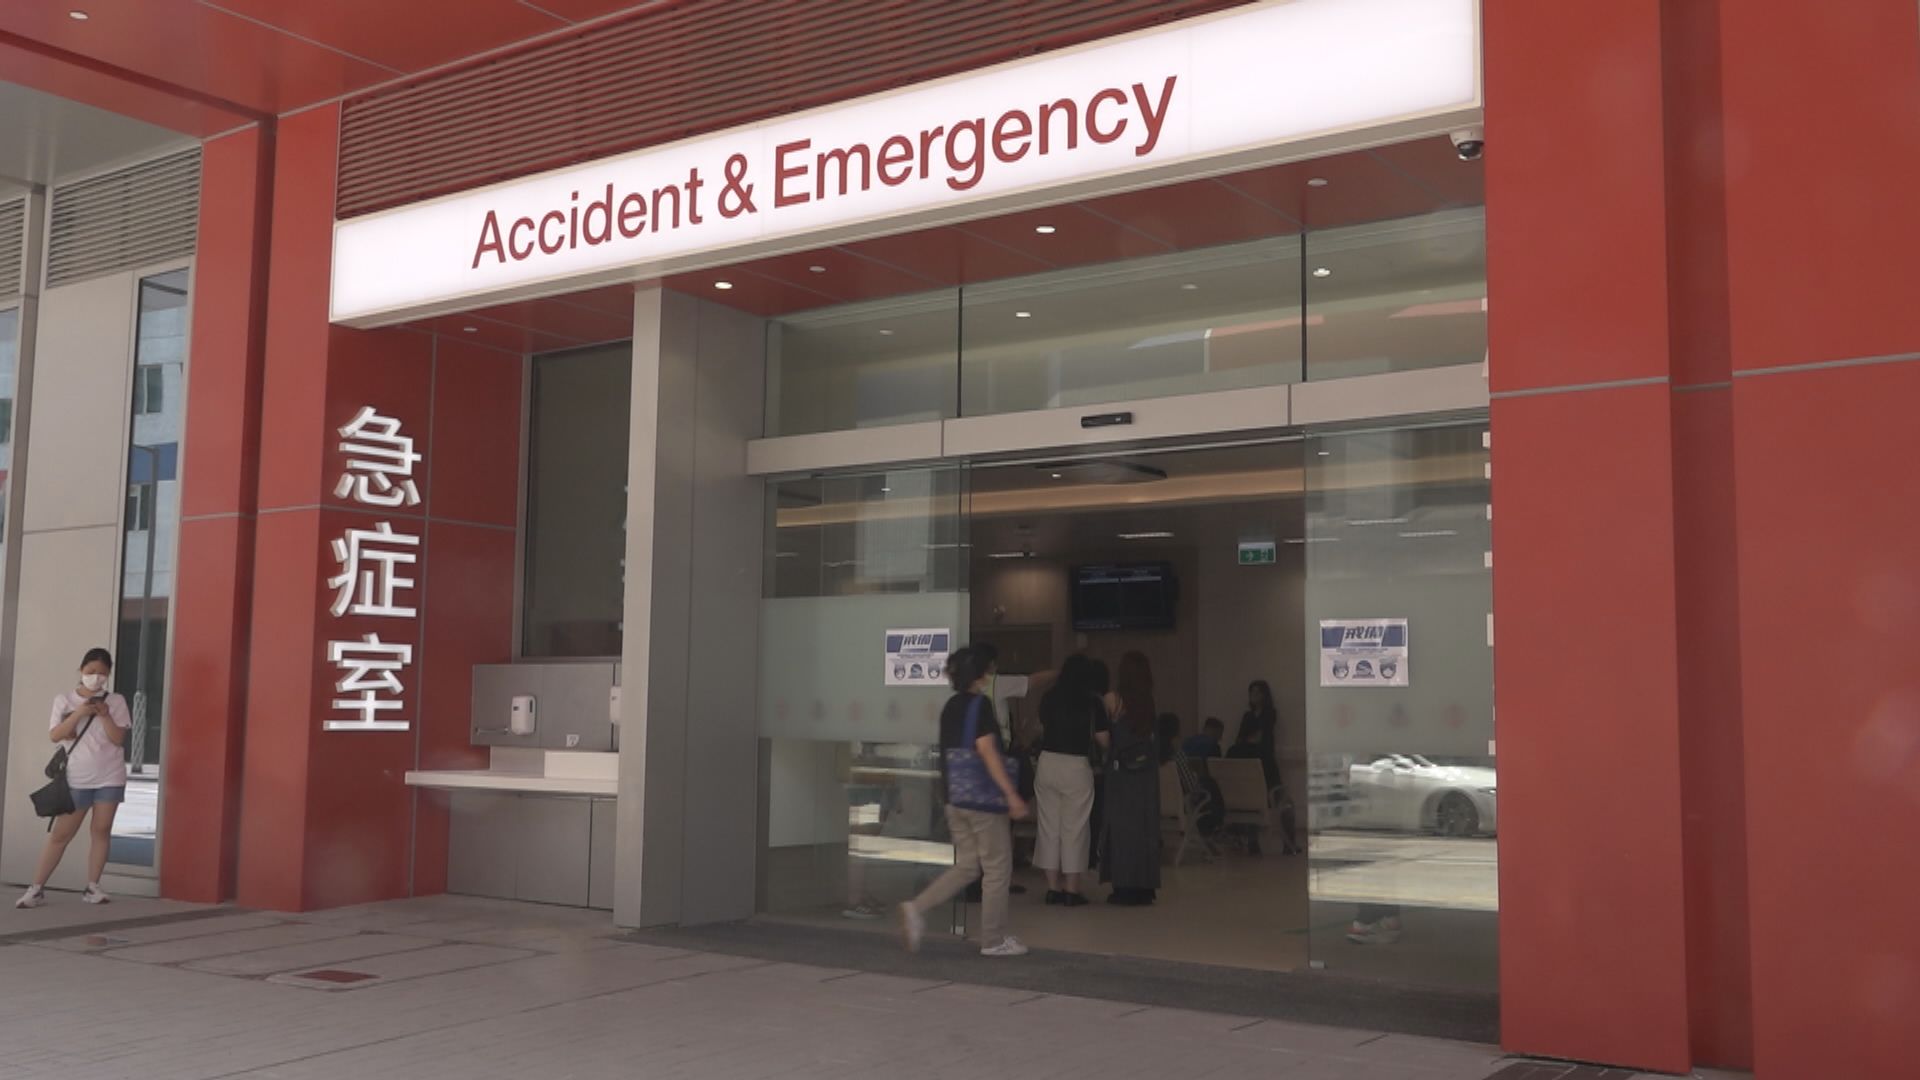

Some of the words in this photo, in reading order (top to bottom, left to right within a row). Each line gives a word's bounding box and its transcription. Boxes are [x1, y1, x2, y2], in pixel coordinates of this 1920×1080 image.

[471, 167, 706, 270] Accident
[717, 156, 758, 220] &
[773, 75, 1178, 209] Emergency
[323, 406, 422, 732] 急症室
